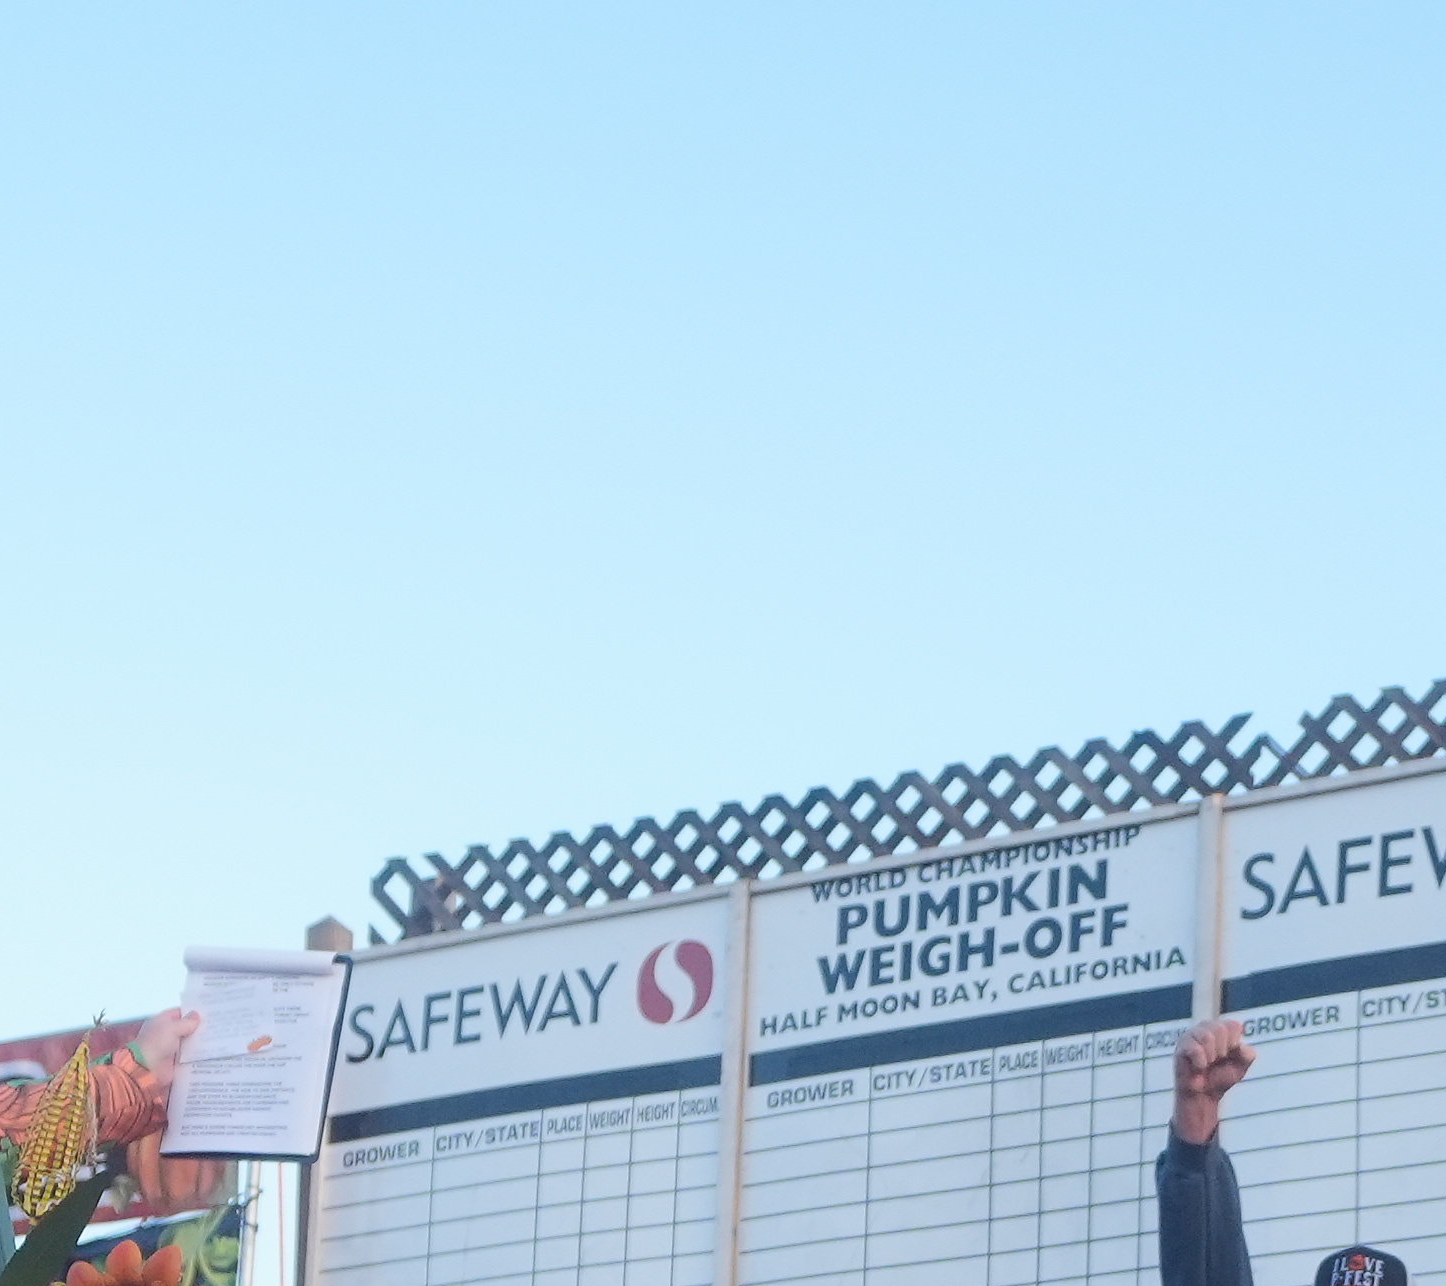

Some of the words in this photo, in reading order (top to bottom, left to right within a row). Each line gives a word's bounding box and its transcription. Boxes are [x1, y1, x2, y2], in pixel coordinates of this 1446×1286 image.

[811, 865, 906, 904] WORLD
[916, 824, 1142, 882] CHAMPIONSHIP
[836, 858, 1108, 946] PUMPKIN
[817, 903, 1130, 996] WEIGH-OFF
[345, 962, 618, 1064] SAFEWAY
[760, 1006, 828, 1038] HALF
[836, 989, 921, 1023] MOON
[932, 978, 1000, 1008] BAY,
[1008, 946, 1187, 995] CALIFORNIA
[1241, 1004, 1341, 1037] GROWER
[766, 1079, 855, 1109] GROWER
[872, 1057, 991, 1092] CITY/STATE
[999, 1050, 1038, 1072] PLACE
[1045, 1041, 1090, 1066] WEIGHT
[1097, 1034, 1139, 1057] HEIGHT
[343, 1140, 421, 1167] GROWER
[435, 1120, 541, 1153] CITY/STATE
[546, 1112, 583, 1136] PLACE
[588, 1107, 631, 1131] WEIGHT
[636, 1100, 676, 1124] HEIGHT
